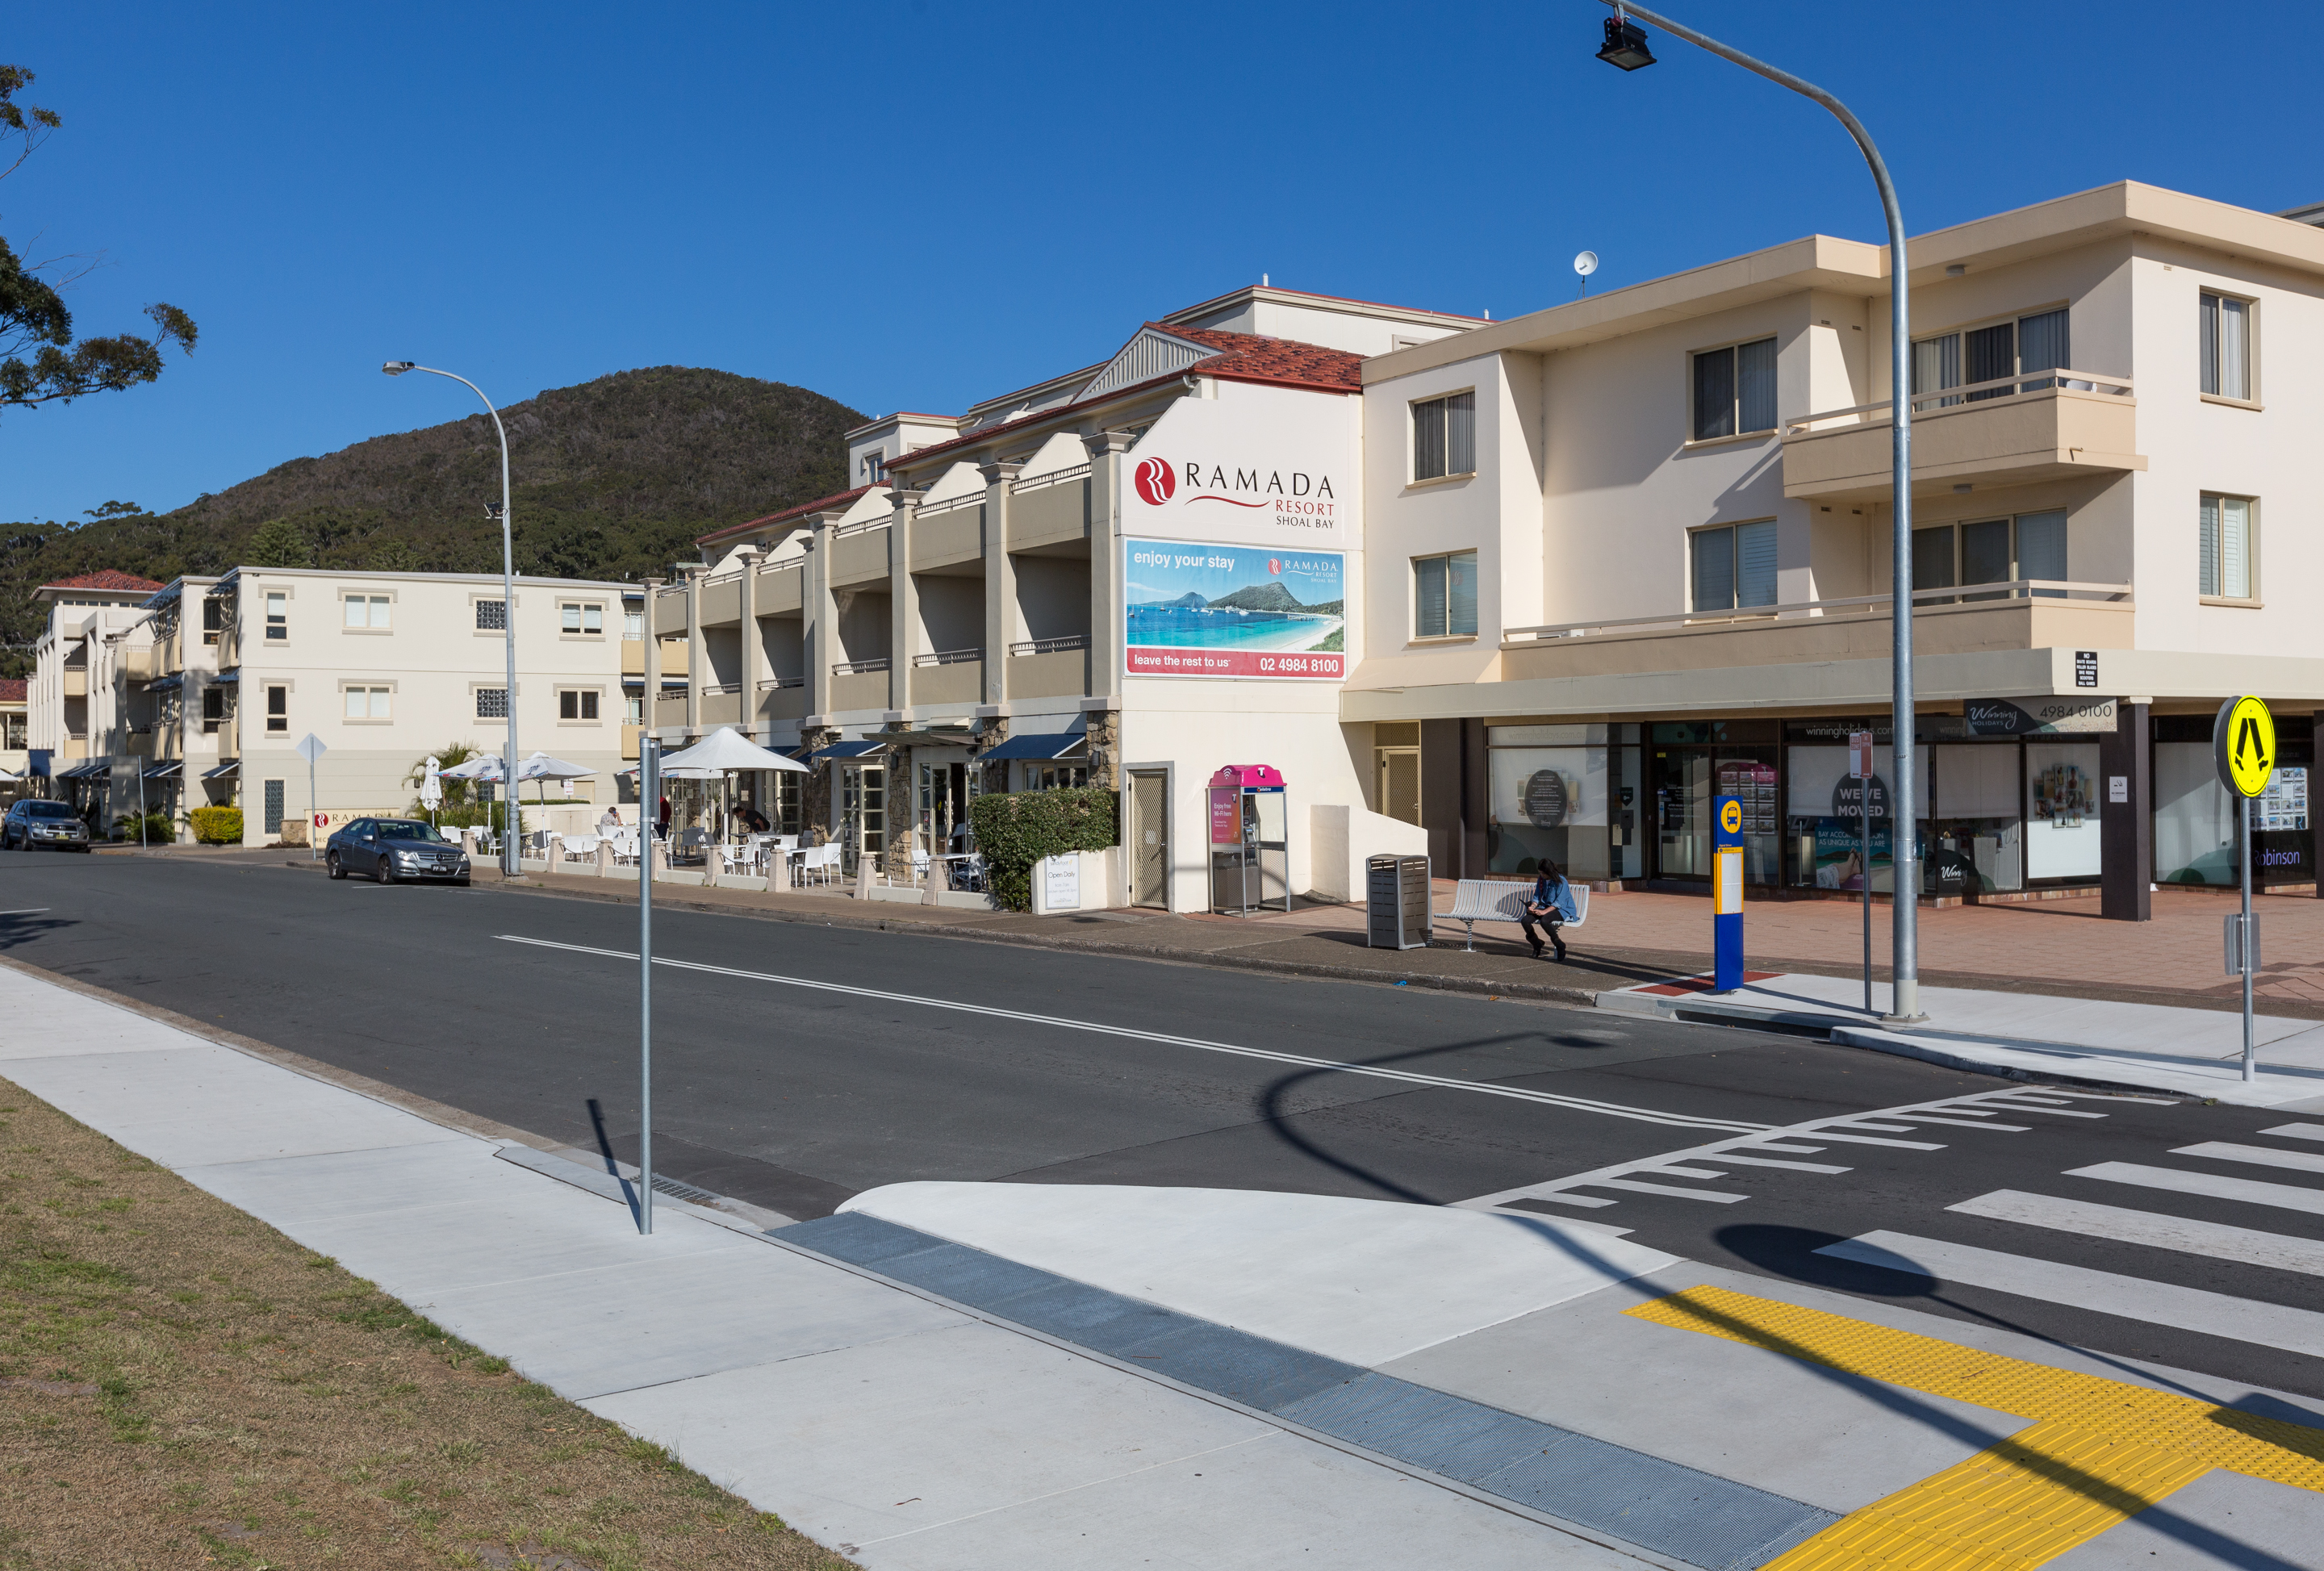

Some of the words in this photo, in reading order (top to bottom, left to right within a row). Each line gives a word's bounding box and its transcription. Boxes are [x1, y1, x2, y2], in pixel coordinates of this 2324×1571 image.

[1186, 462, 1334, 499] RAMADA
[1276, 499, 1335, 516] RESORT
[1276, 516, 1311, 528] SHOAL
[1315, 518, 1335, 529] BAY
[1134, 551, 1171, 568] enjoy
[1174, 555, 1204, 569] your
[1208, 556, 1235, 571] stay
[1135, 654, 1162, 666] leave
[1164, 655, 1180, 666] the
[1182, 657, 1202, 667] rest
[1204, 658, 1214, 667] to
[1260, 658, 1275, 671] 02
[1278, 658, 1307, 672] 4984
[1311, 658, 1339, 672] 8100
[1971, 705, 2017, 729] Winning
[2040, 705, 2074, 717] 4984
[2079, 705, 2112, 717] 0100
[1838, 805, 1883, 816] MOVED
[2255, 848, 2300, 866] Robinson
[1941, 864, 1967, 886] Winning
